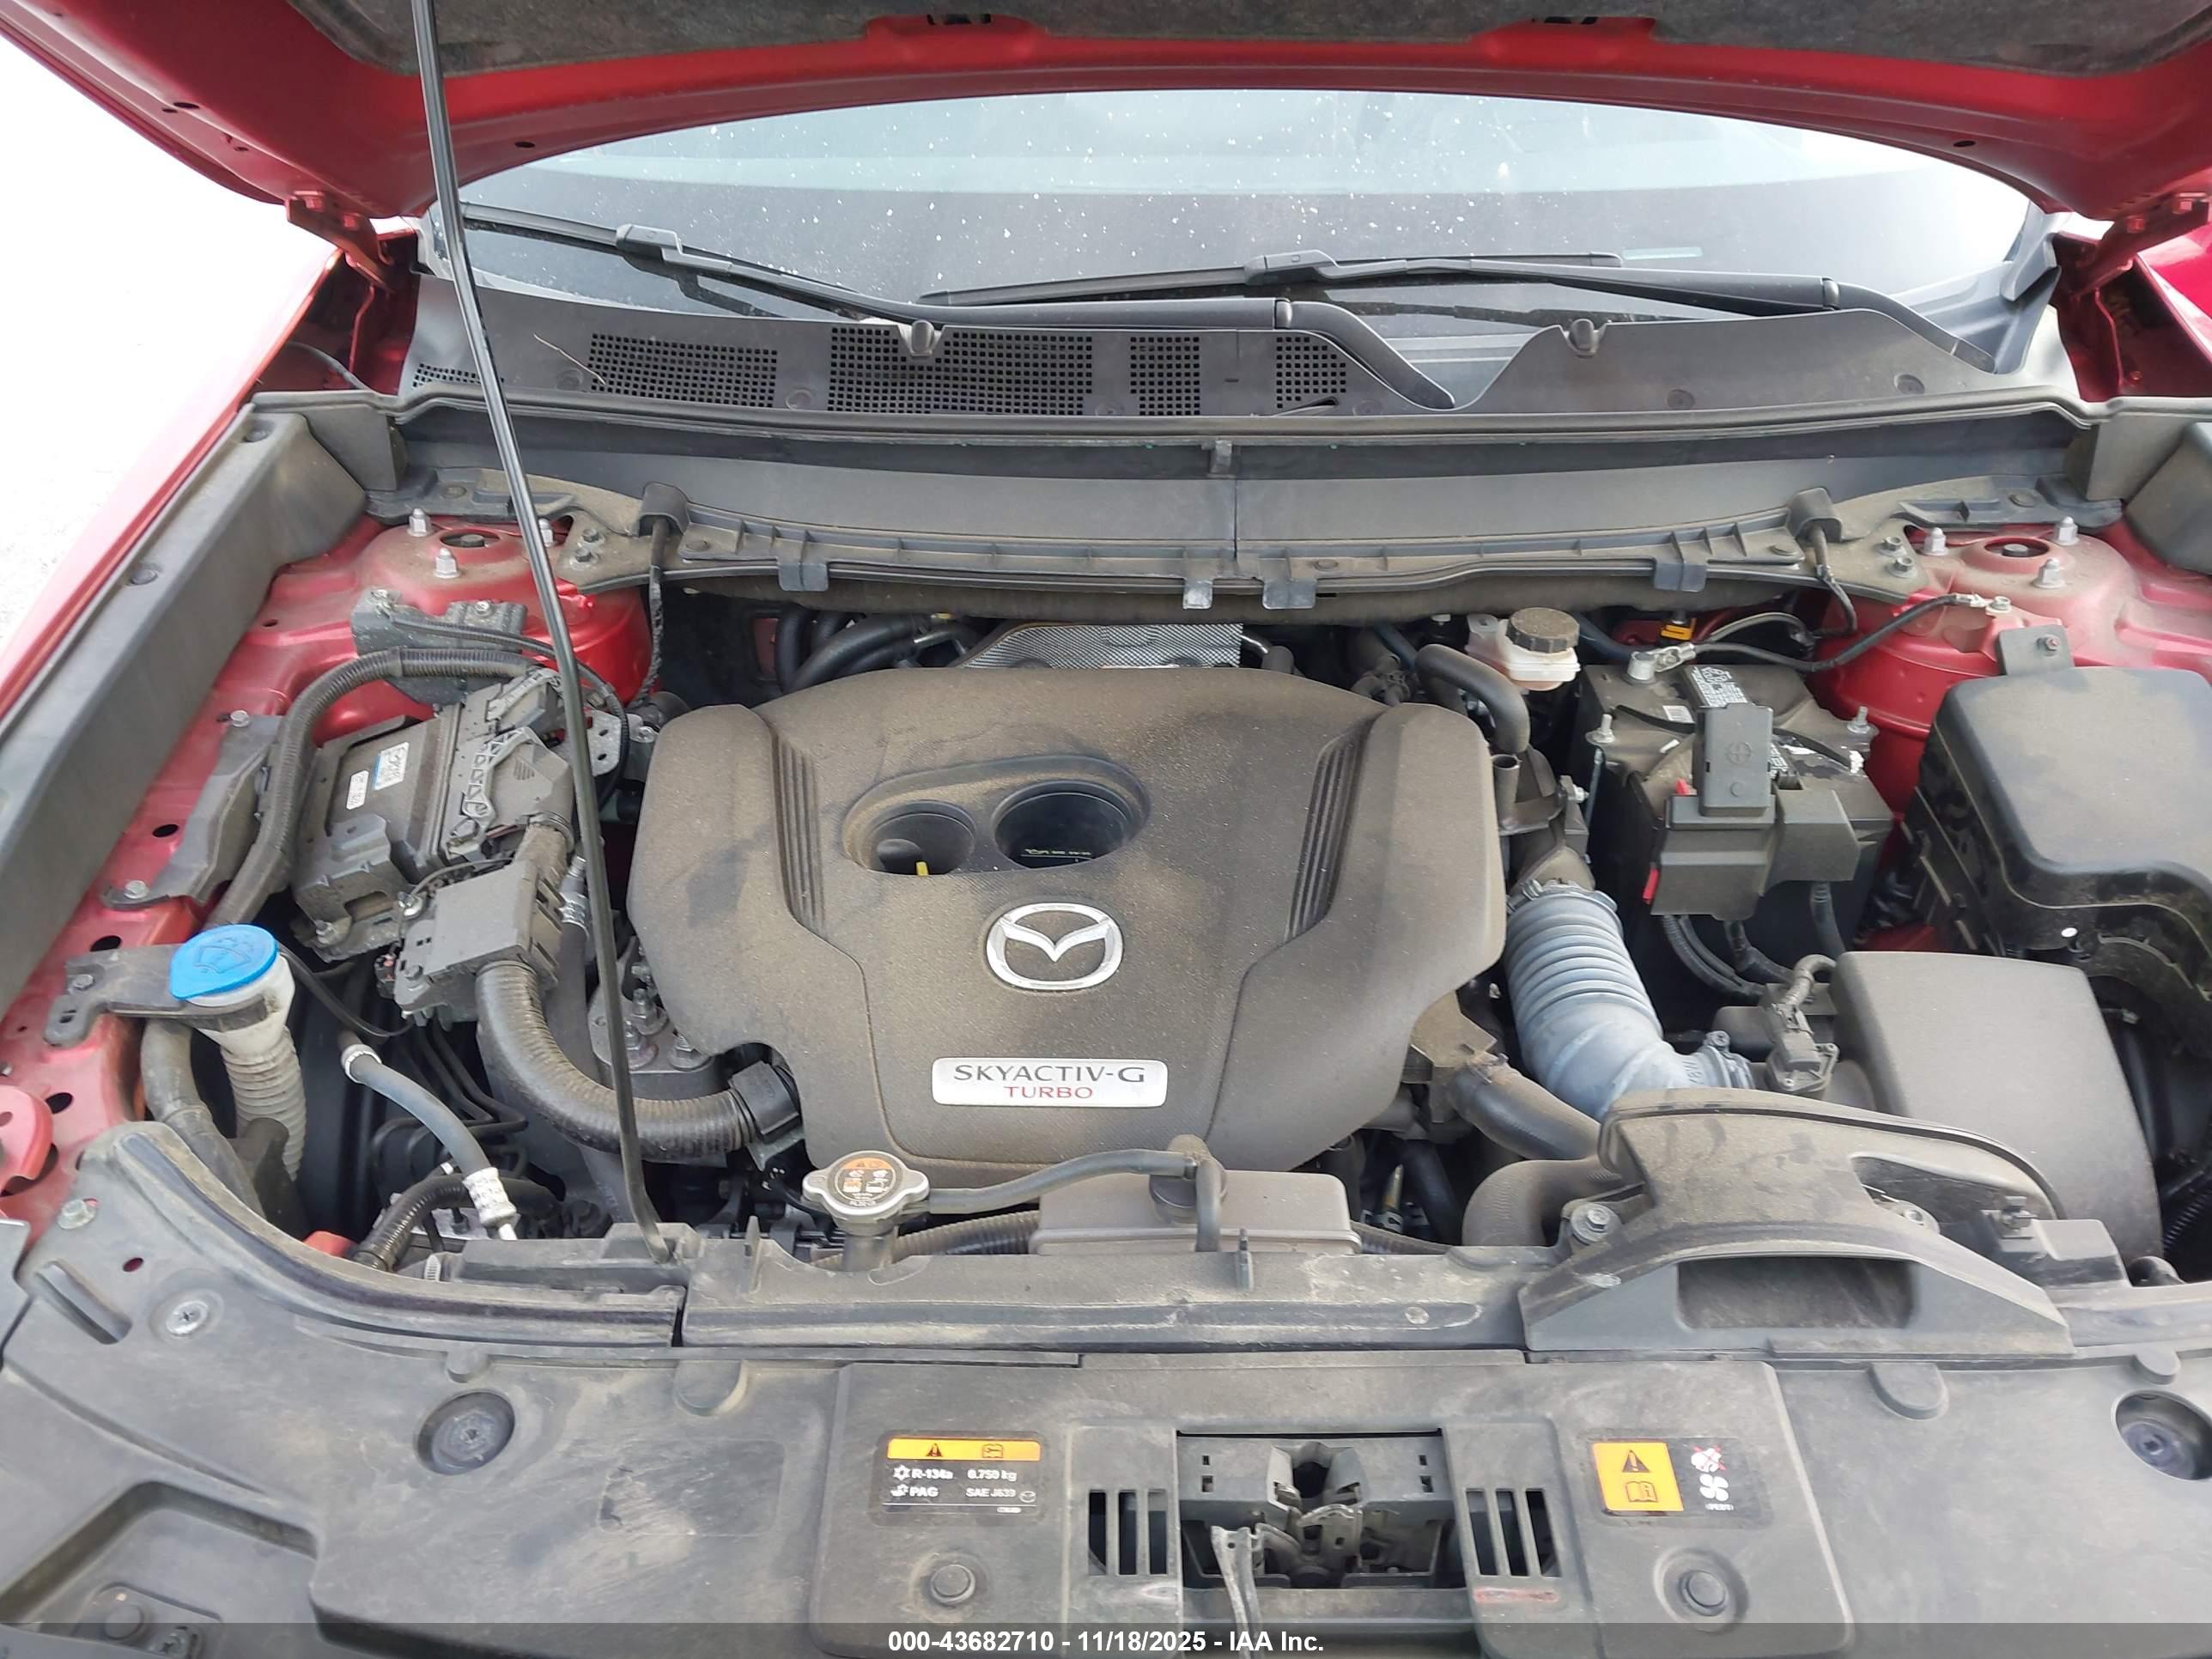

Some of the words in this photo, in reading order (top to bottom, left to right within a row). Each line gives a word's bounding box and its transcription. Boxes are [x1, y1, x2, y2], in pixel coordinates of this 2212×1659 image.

[953, 1064, 1146, 1084] SKYACTIV-G
[1003, 1085, 1094, 1099] TURBO
[1000, 1469, 1018, 1482] kg
[909, 1486, 939, 1498] PAG
[965, 1487, 989, 1498] SAE
